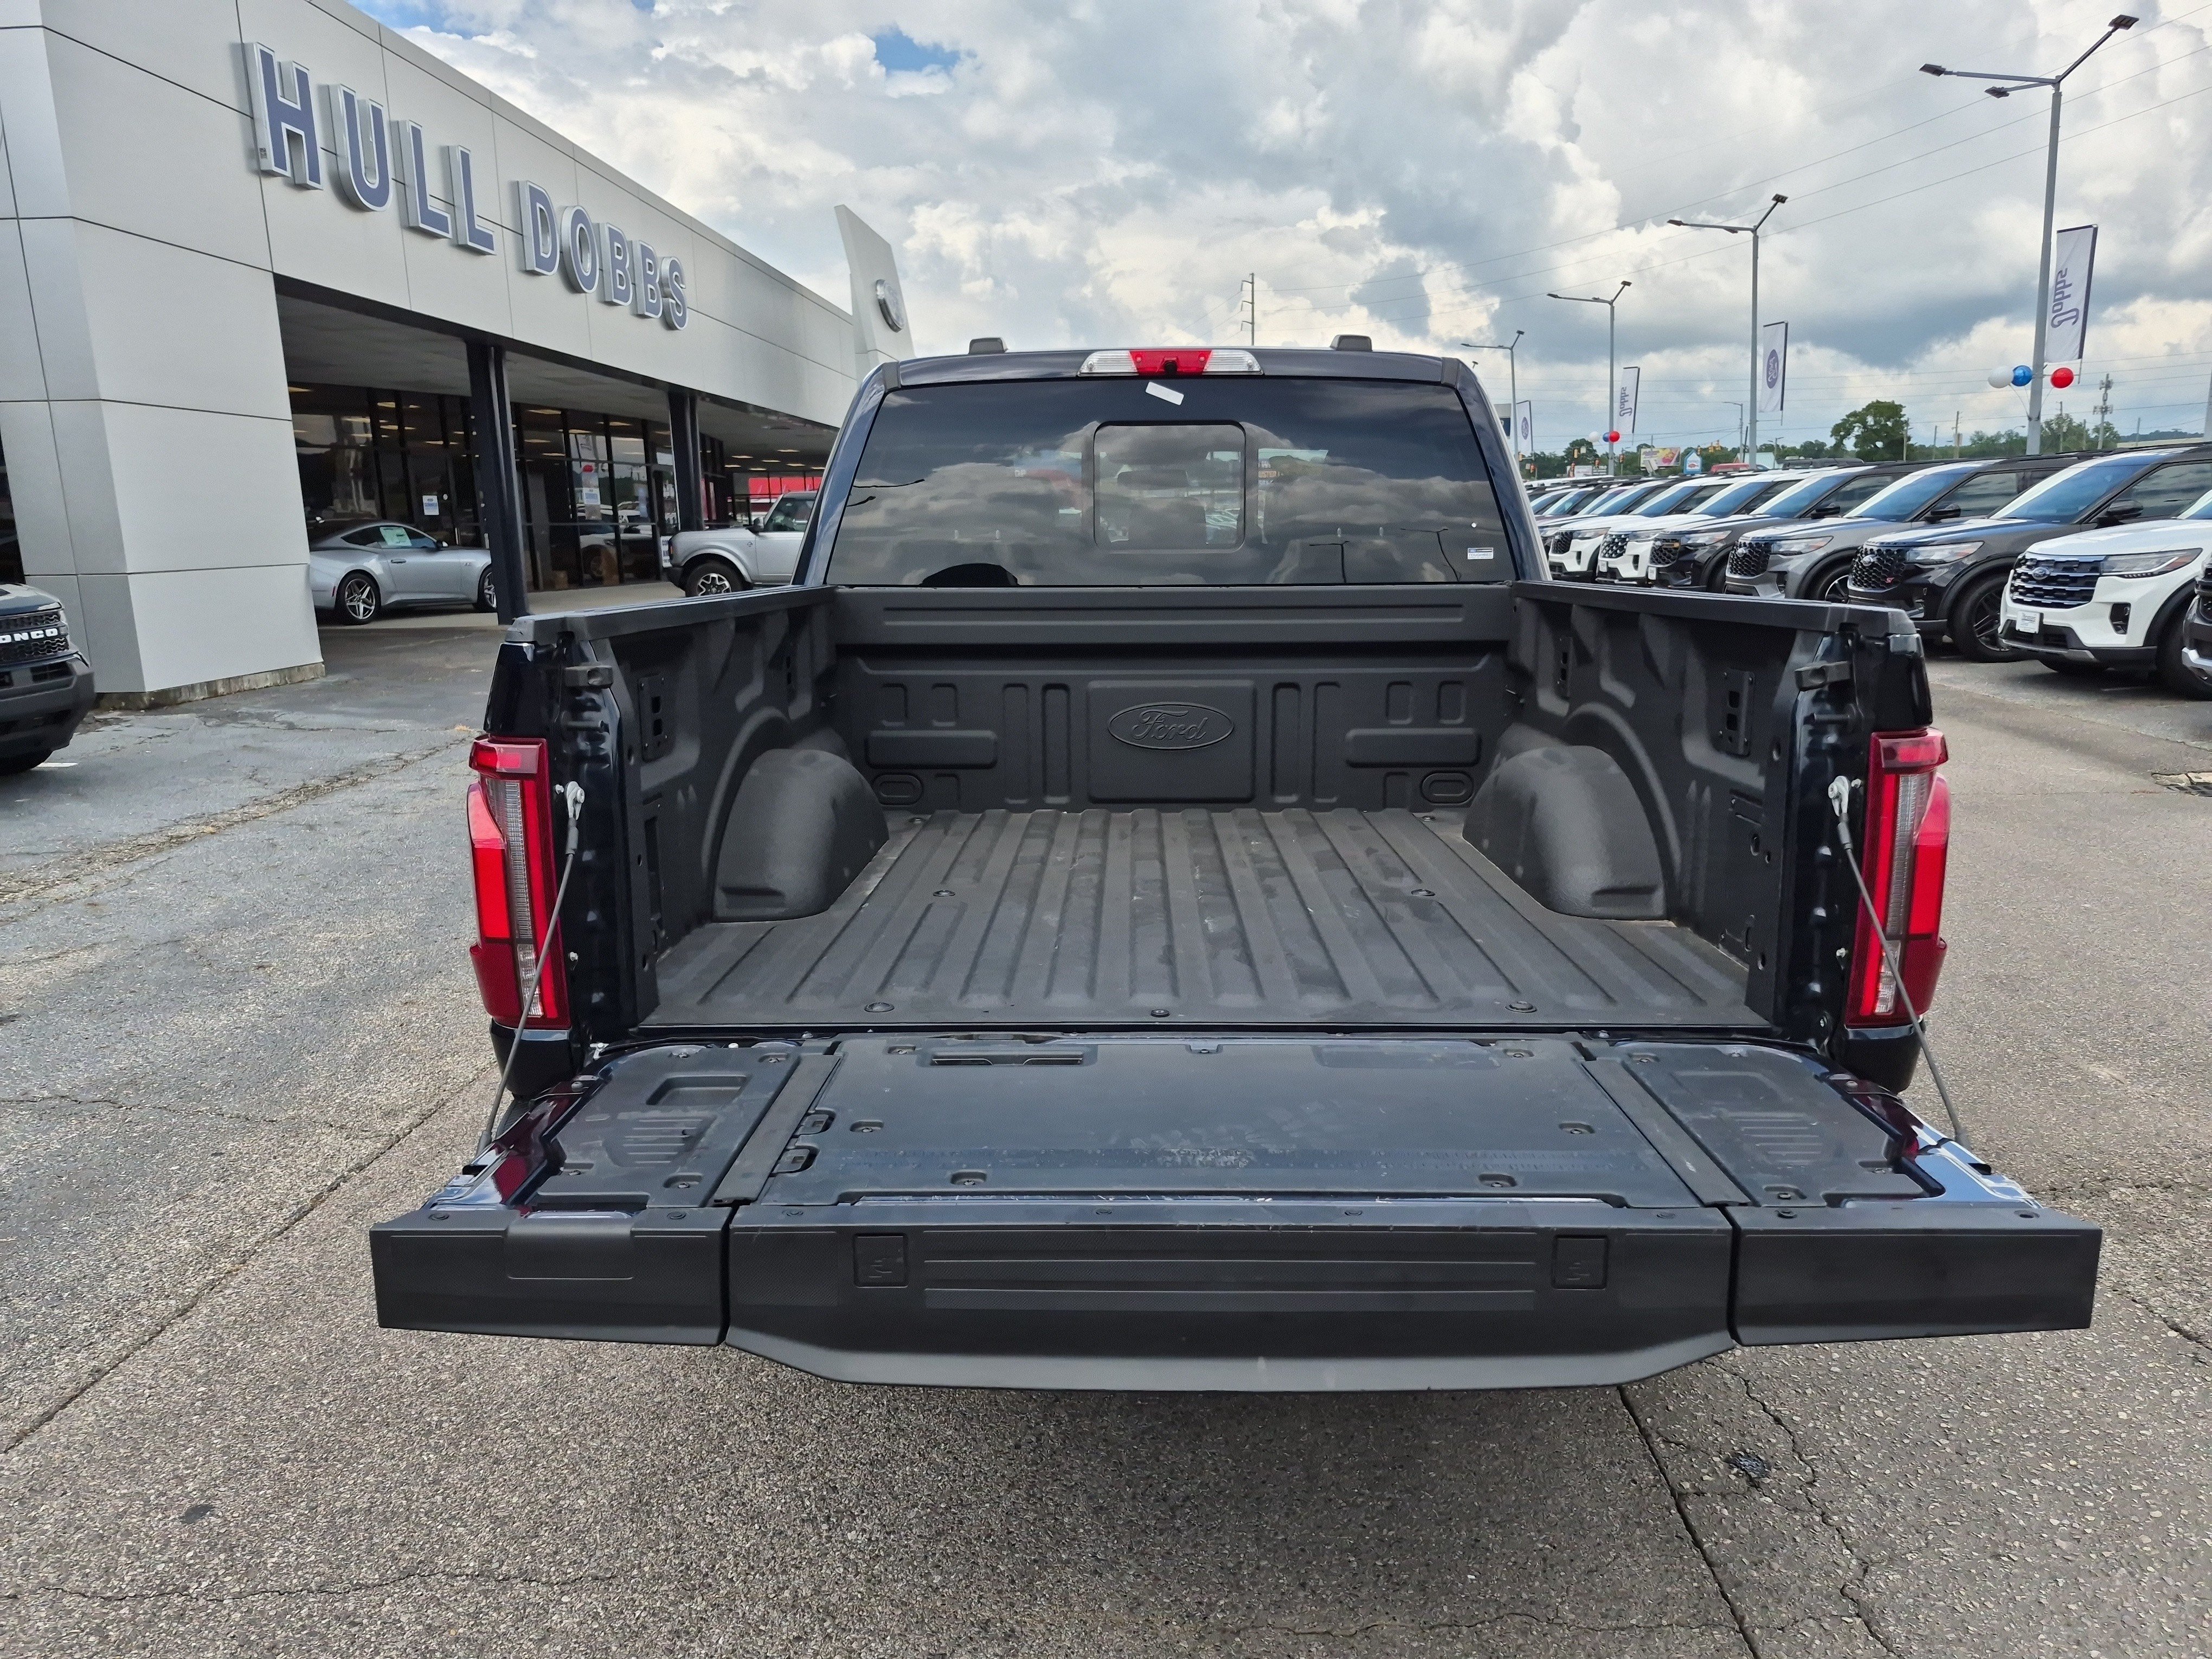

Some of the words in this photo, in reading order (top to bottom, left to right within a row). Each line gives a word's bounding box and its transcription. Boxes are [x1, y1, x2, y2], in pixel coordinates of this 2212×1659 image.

[243, 42, 496, 255] HULL
[518, 180, 688, 331] DOBBS
[1131, 709, 1208, 741] Ford
